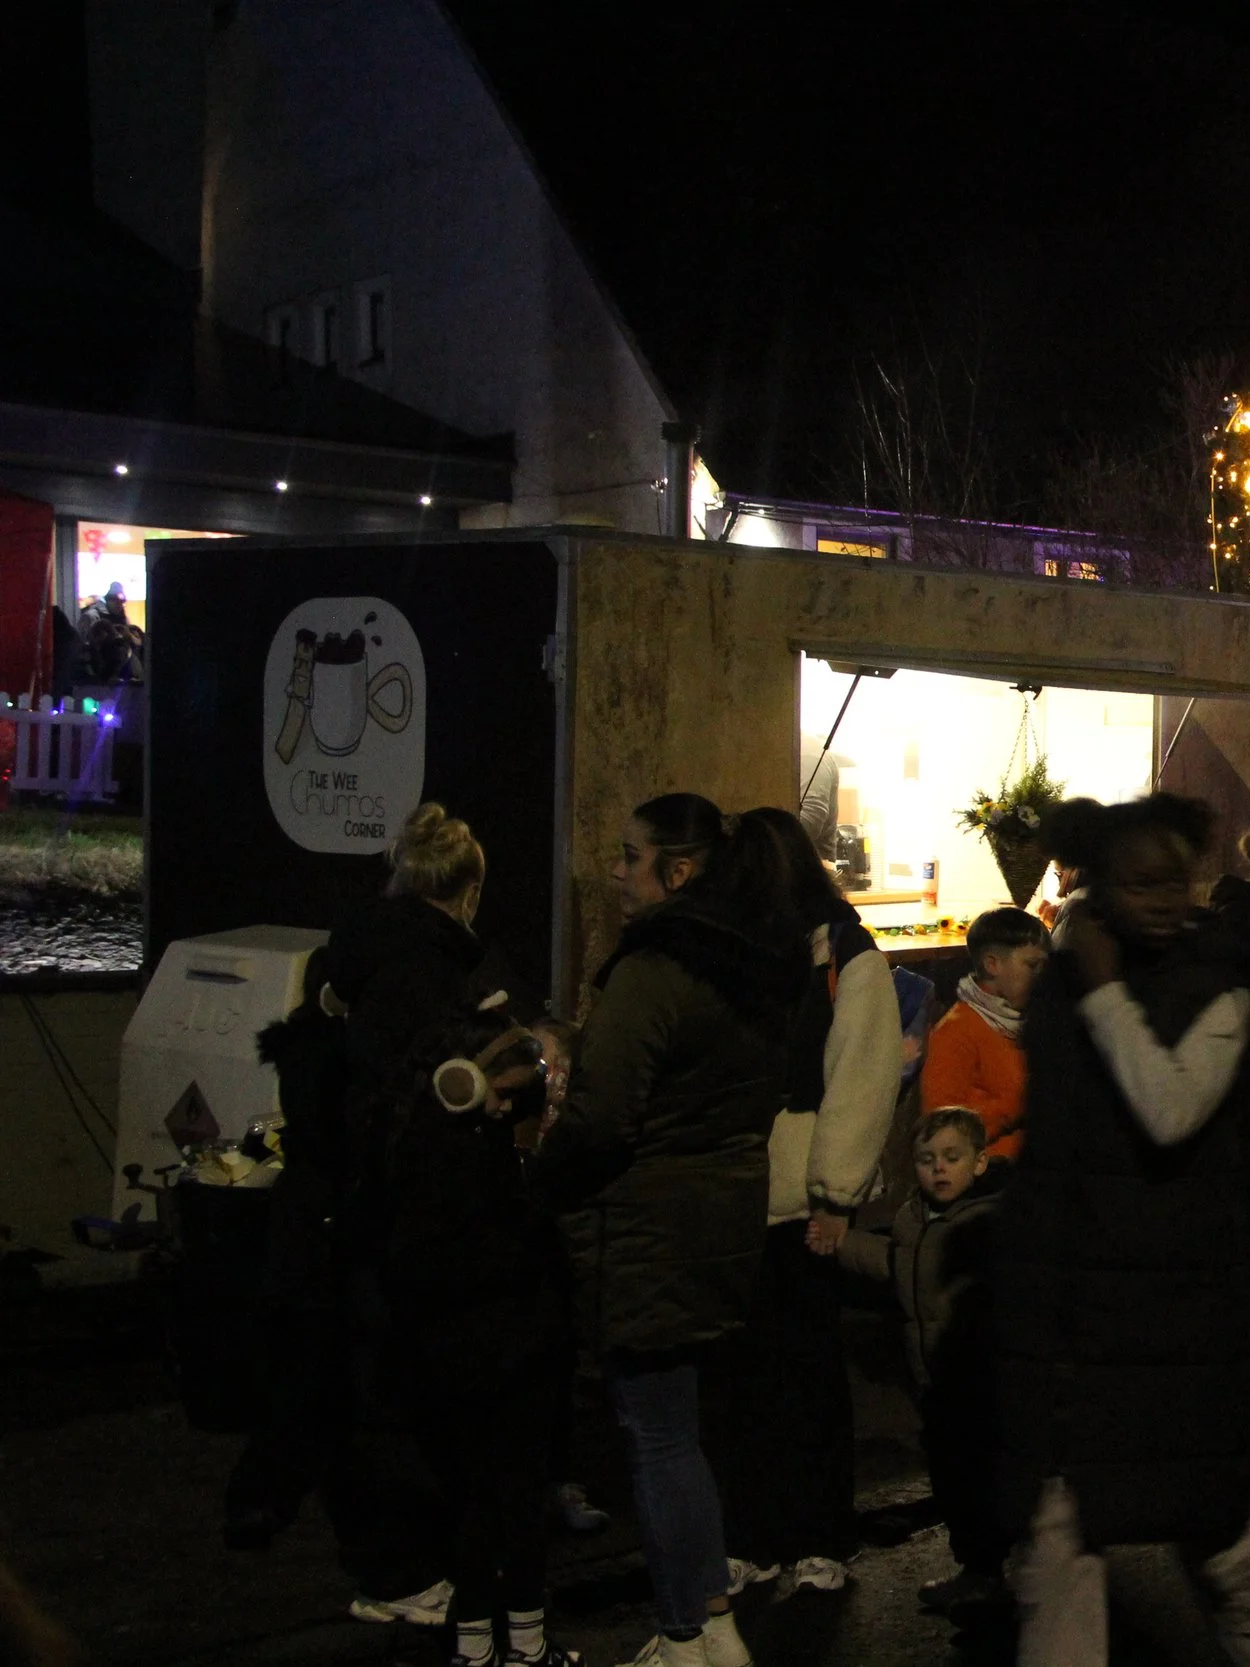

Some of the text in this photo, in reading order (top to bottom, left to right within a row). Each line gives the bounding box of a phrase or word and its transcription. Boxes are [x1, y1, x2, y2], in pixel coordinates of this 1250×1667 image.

[308, 770, 359, 791] THE WEE
[290, 769, 386, 819] Churros
[344, 820, 386, 838] CORNER
